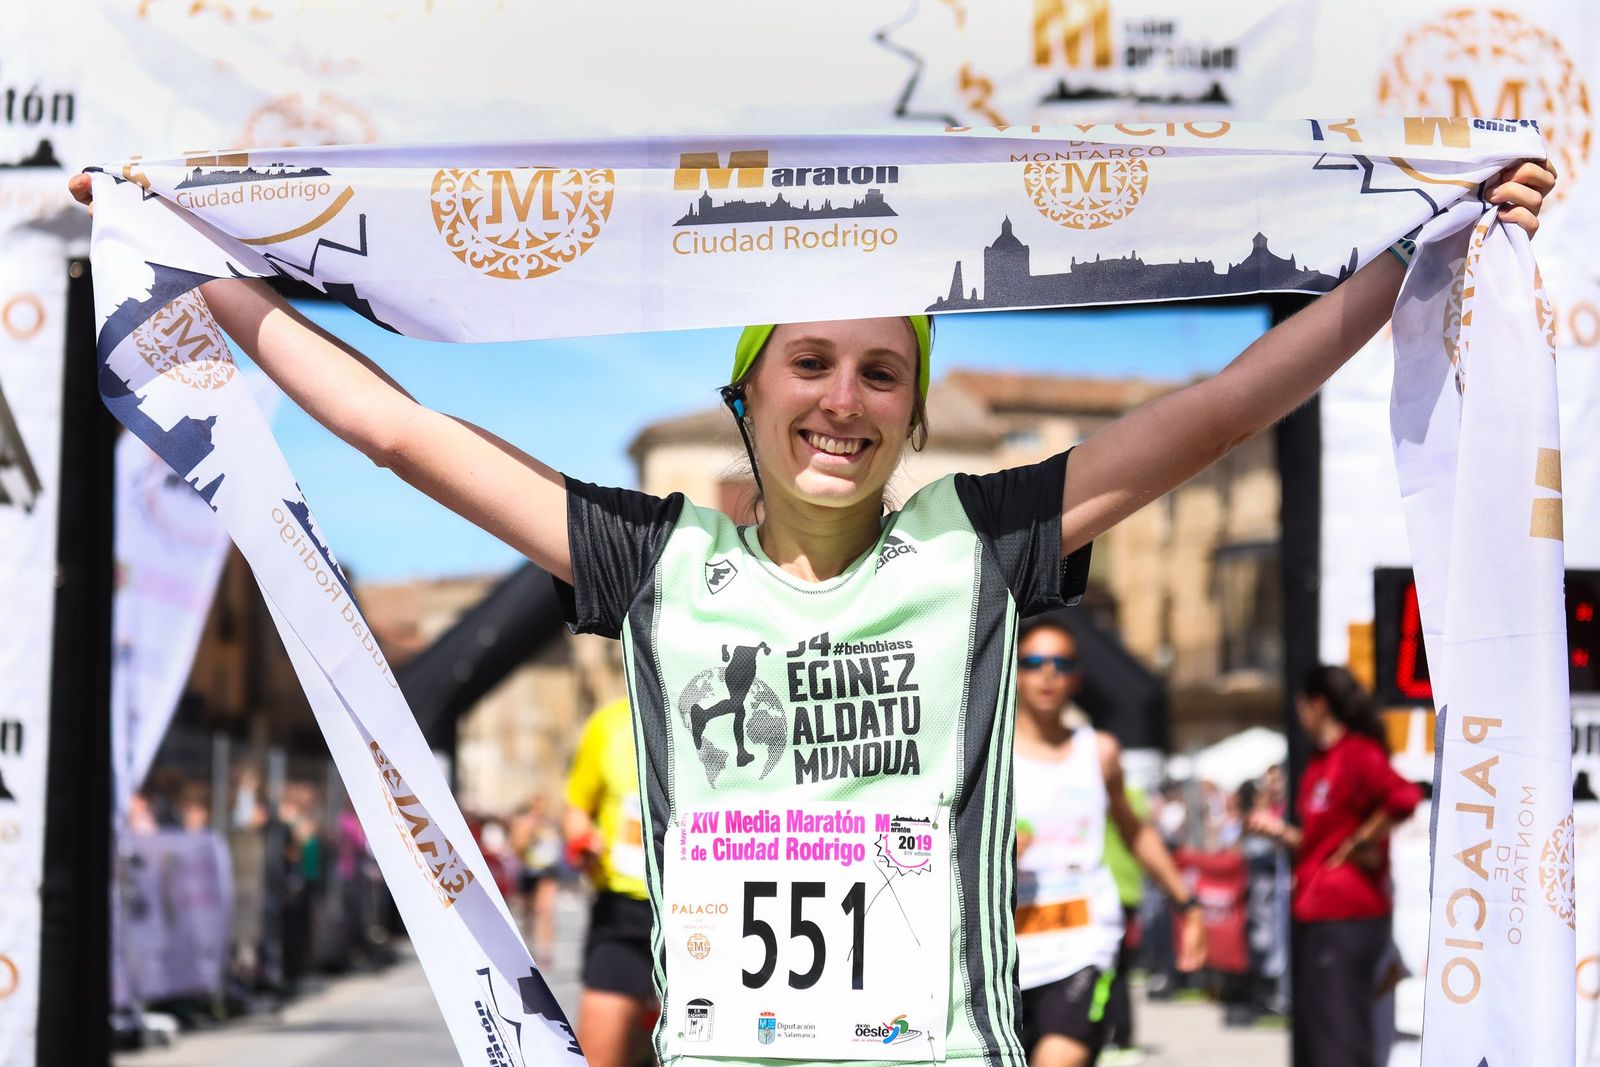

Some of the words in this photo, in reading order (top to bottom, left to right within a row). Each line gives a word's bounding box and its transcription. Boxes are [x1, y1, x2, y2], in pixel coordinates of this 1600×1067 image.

[175, 186, 244, 209] Ciudad
[251, 182, 331, 202] Rodrigo
[672, 226, 774, 255] Ciudad
[784, 223, 898, 253] Rodrigo
[833, 641, 913, 656] #behobiass
[787, 653, 919, 702] EGINEZ
[792, 696, 921, 746] ALDATU
[794, 739, 921, 785] MUNDUA
[690, 811, 720, 834] XIV
[725, 810, 781, 834] Media
[786, 809, 865, 834] Maratón
[691, 845, 707, 861] de
[713, 837, 779, 861] Ciudad
[786, 837, 865, 867] Rodrigo
[898, 834, 932, 851] 2019
[671, 903, 729, 915] PALACIO
[742, 881, 866, 990] 551
[777, 1022, 816, 1031] Diputación
[855, 1025, 890, 1038] oeste
